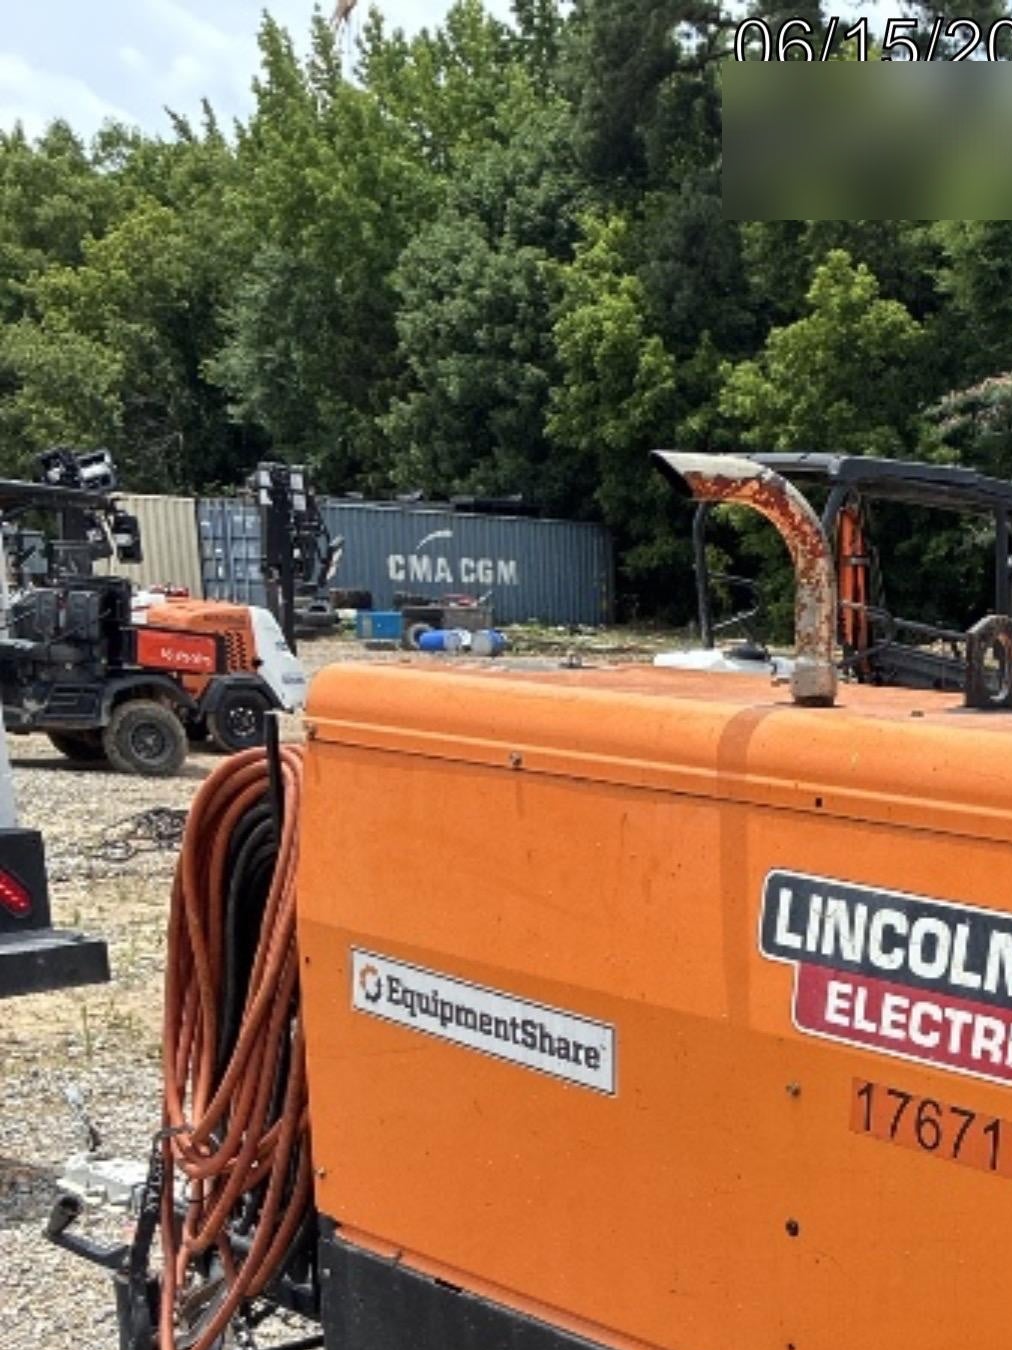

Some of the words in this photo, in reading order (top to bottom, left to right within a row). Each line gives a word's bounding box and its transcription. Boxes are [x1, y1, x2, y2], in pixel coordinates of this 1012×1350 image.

[388, 554, 454, 583] CMA
[460, 557, 517, 585] CGM
[386, 974, 602, 1072] EquipmentShare
